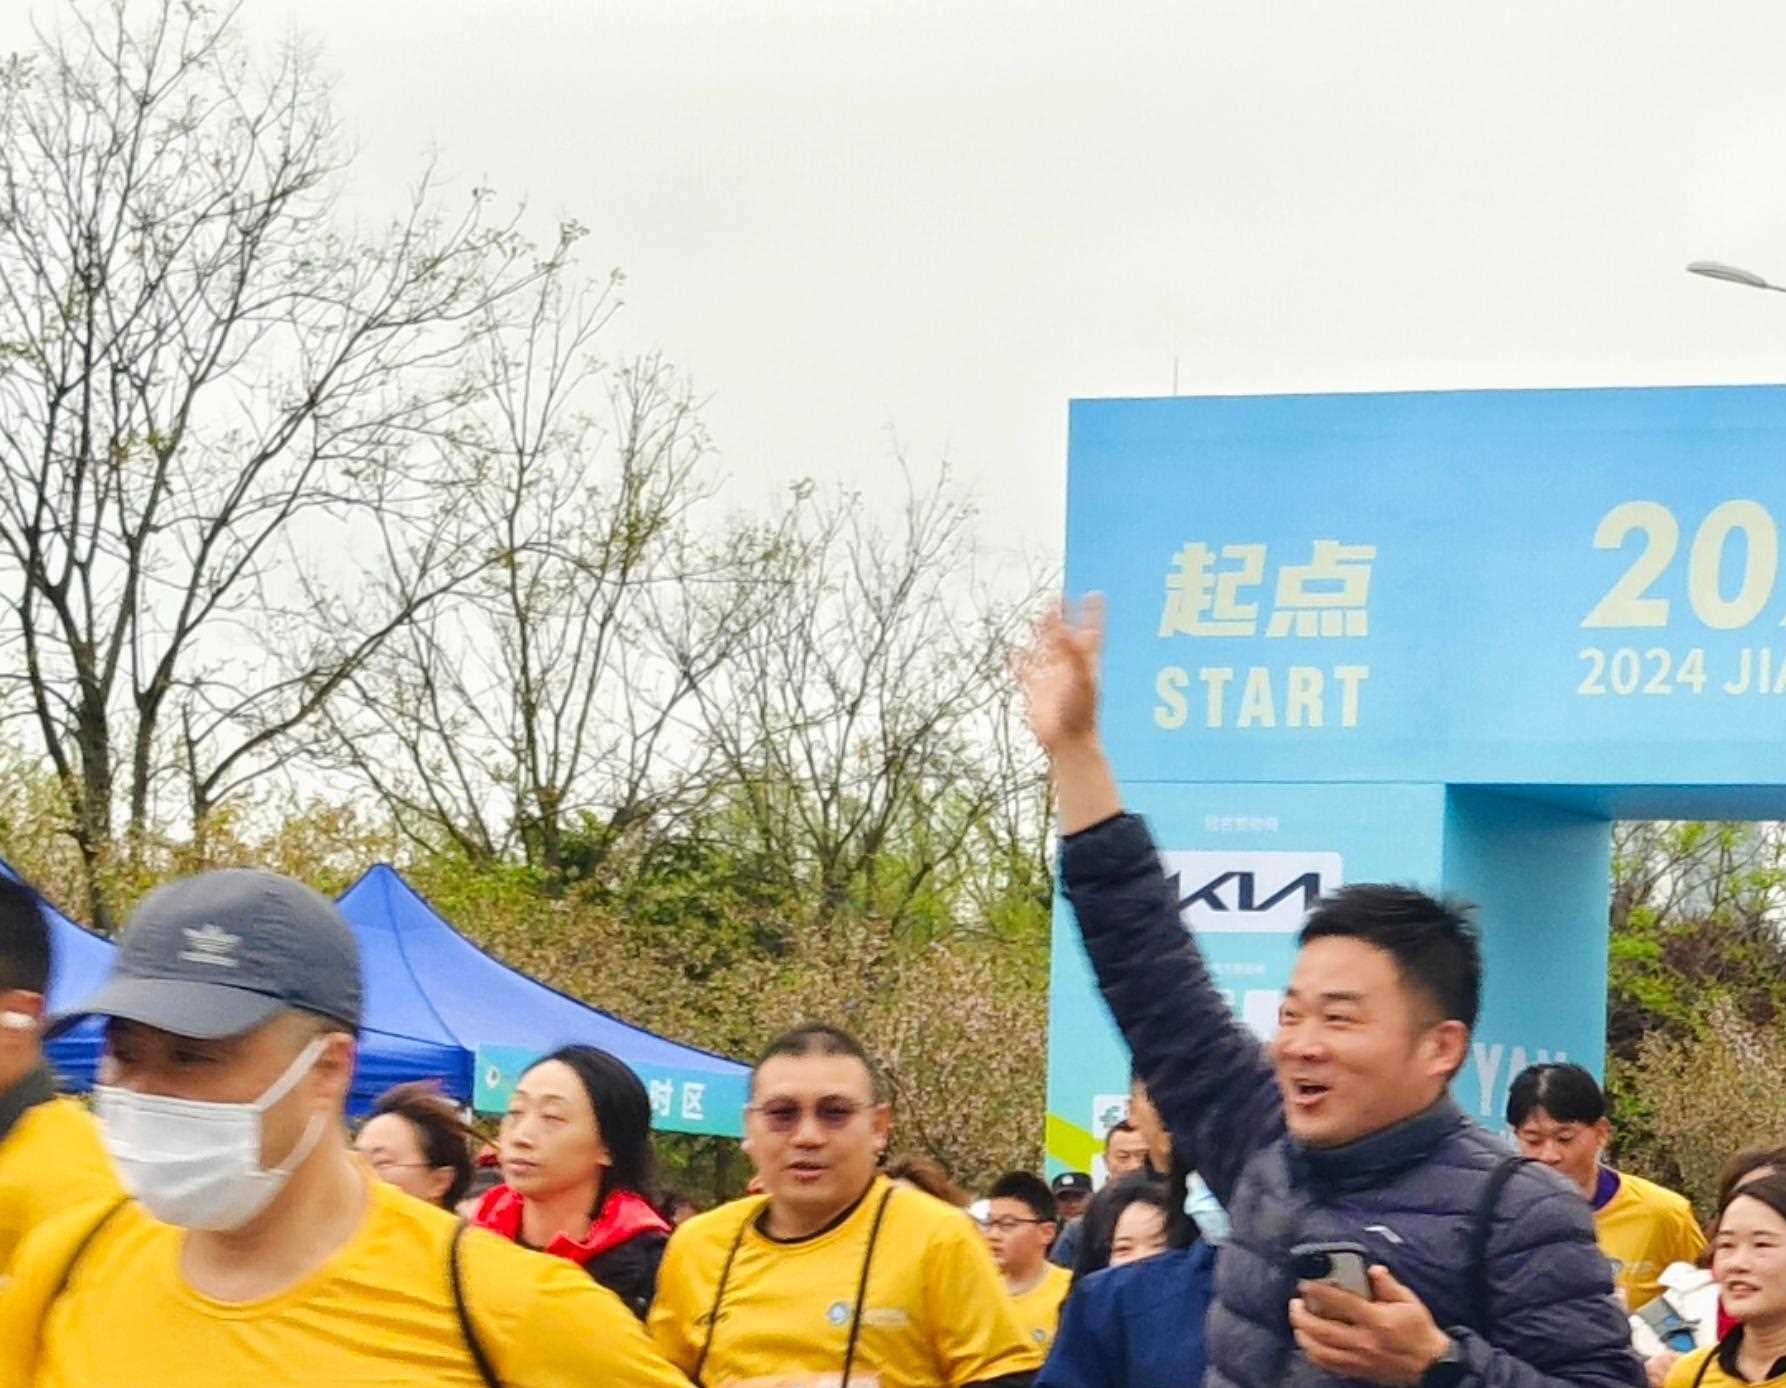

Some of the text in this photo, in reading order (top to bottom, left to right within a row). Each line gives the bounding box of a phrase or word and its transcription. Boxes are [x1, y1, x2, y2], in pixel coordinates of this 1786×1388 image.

[1159, 540, 1378, 639] 起点
[1154, 665, 1371, 731] START
[1580, 648, 1707, 698] 2024
